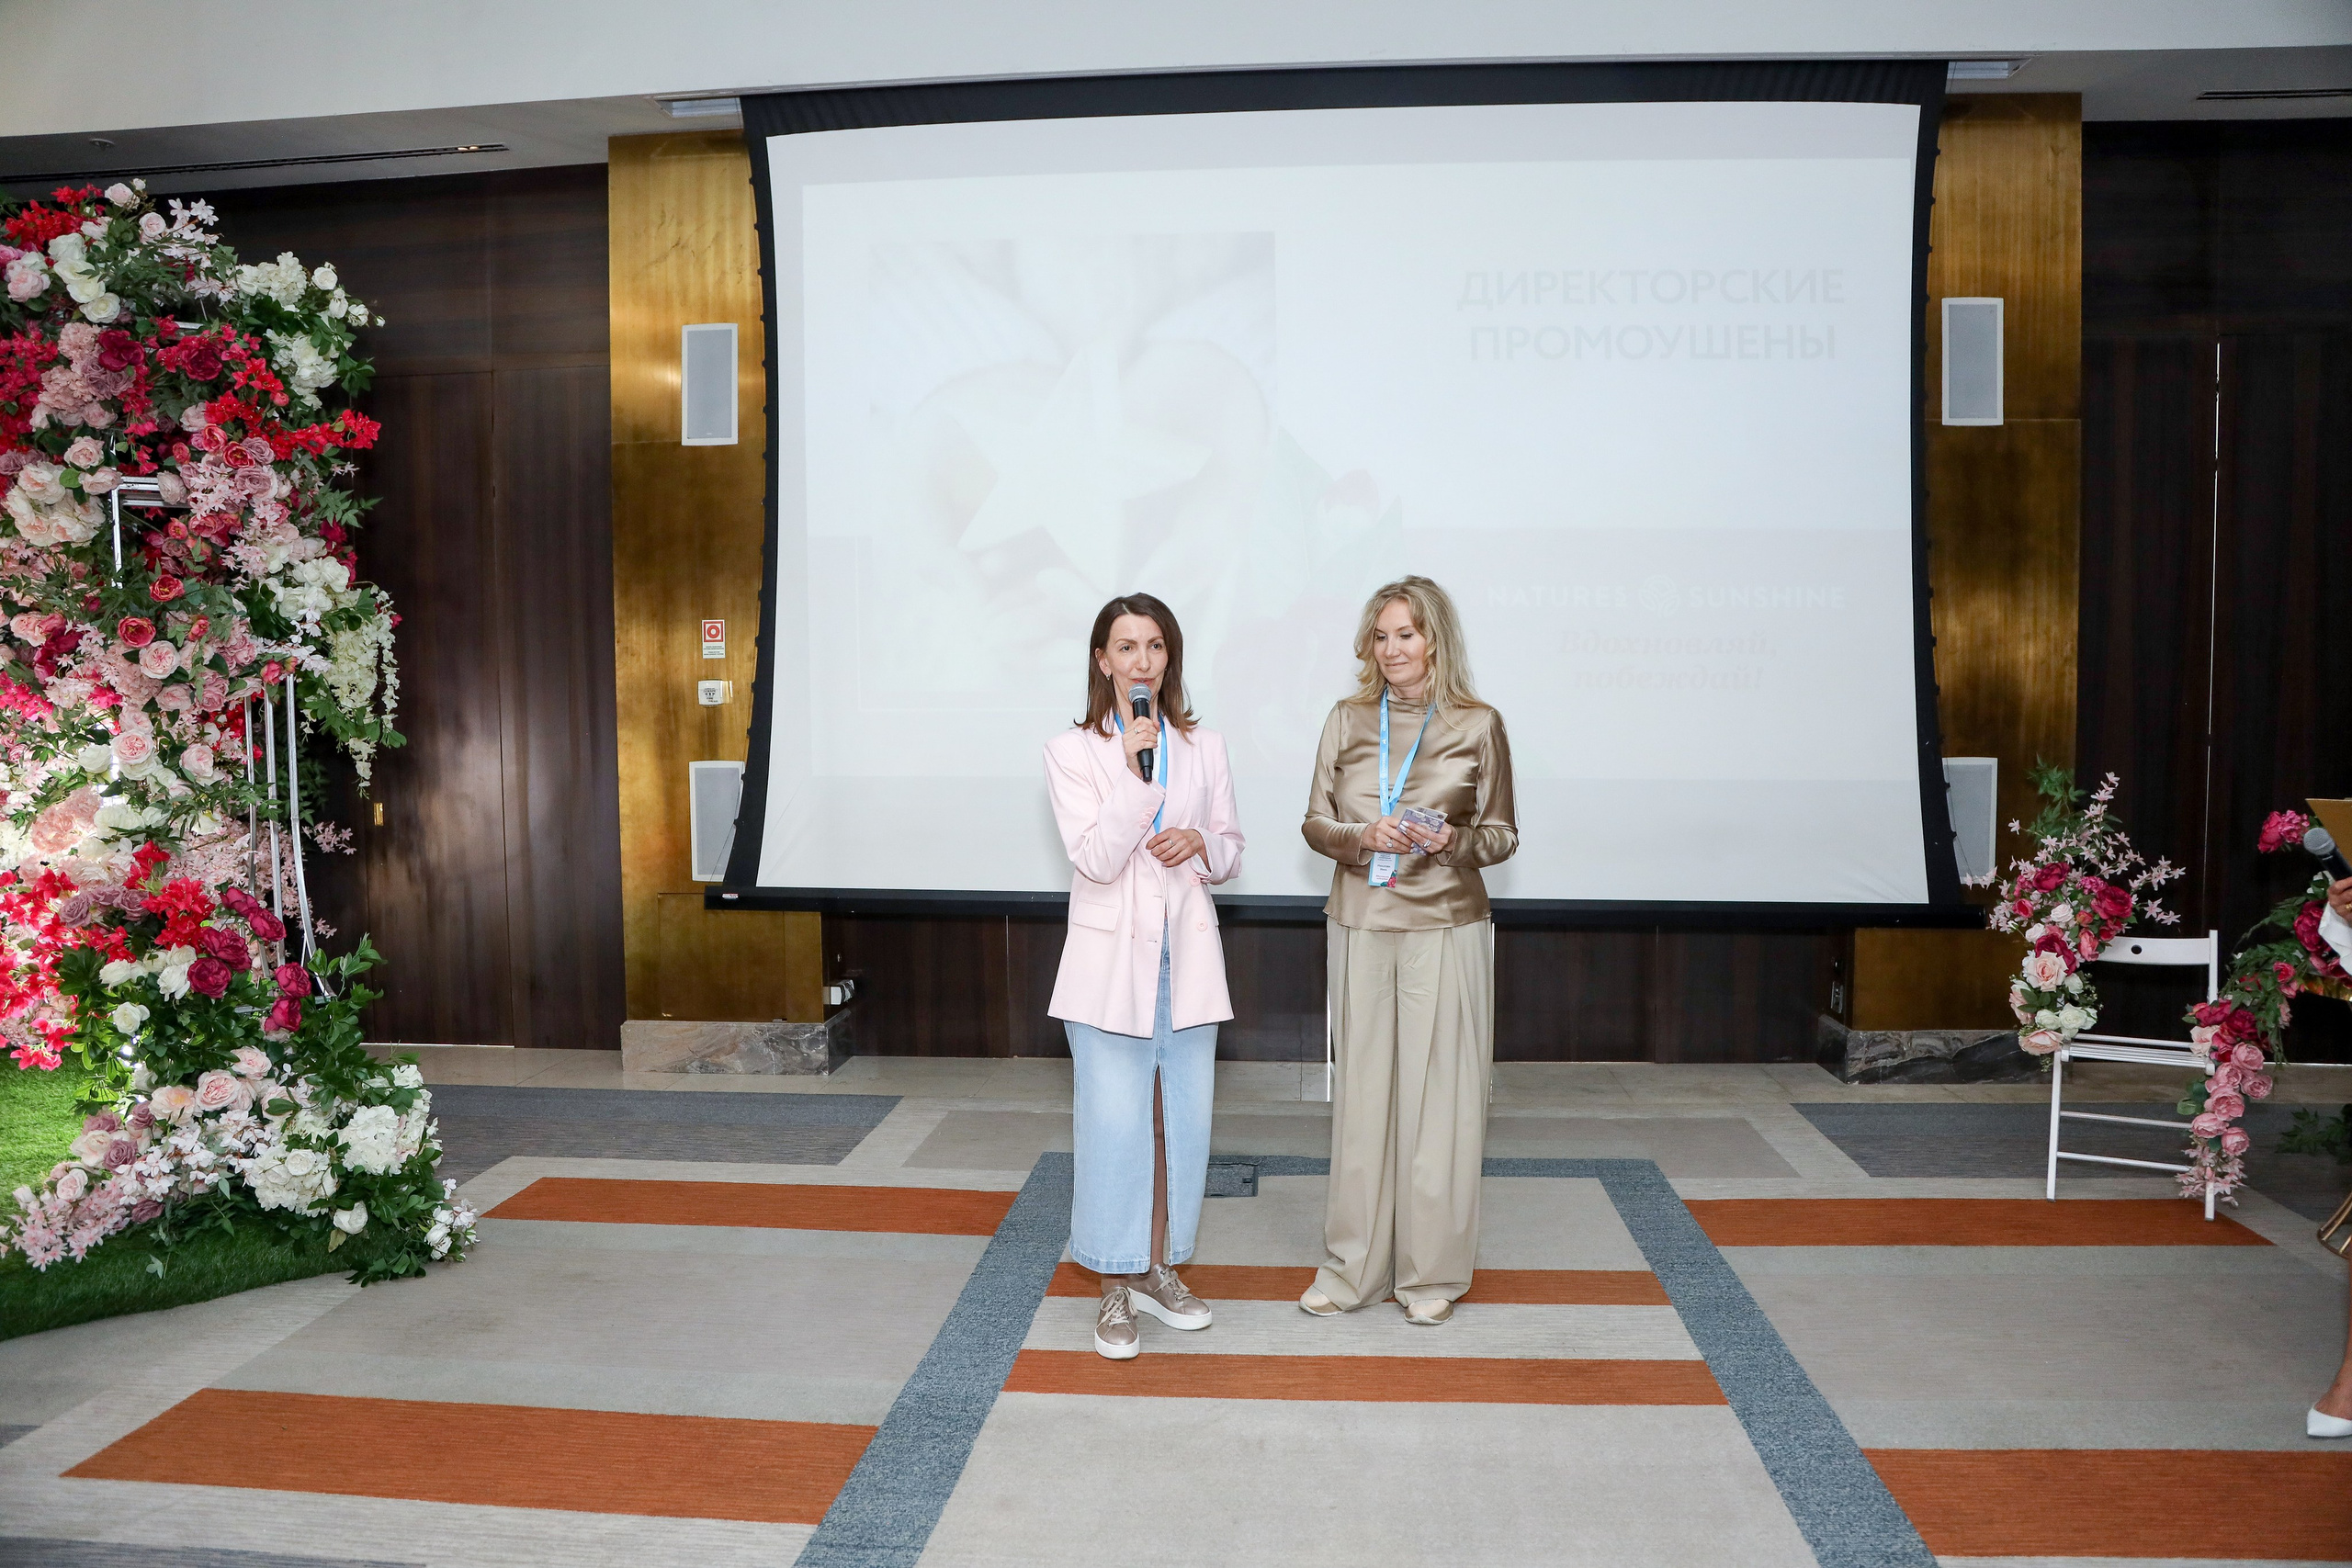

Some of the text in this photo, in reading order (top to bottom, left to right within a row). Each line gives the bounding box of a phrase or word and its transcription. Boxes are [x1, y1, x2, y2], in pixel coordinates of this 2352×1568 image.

[1456, 268, 1845, 310] ДИРЕКТОРСКИЕ
[1470, 323, 1836, 361] ПРОМОУШЕНЫ
[1689, 584, 1846, 610] SUNSHINE
[1556, 629, 1778, 659] Вдохновляй,
[1573, 665, 1764, 691] побеждай!
